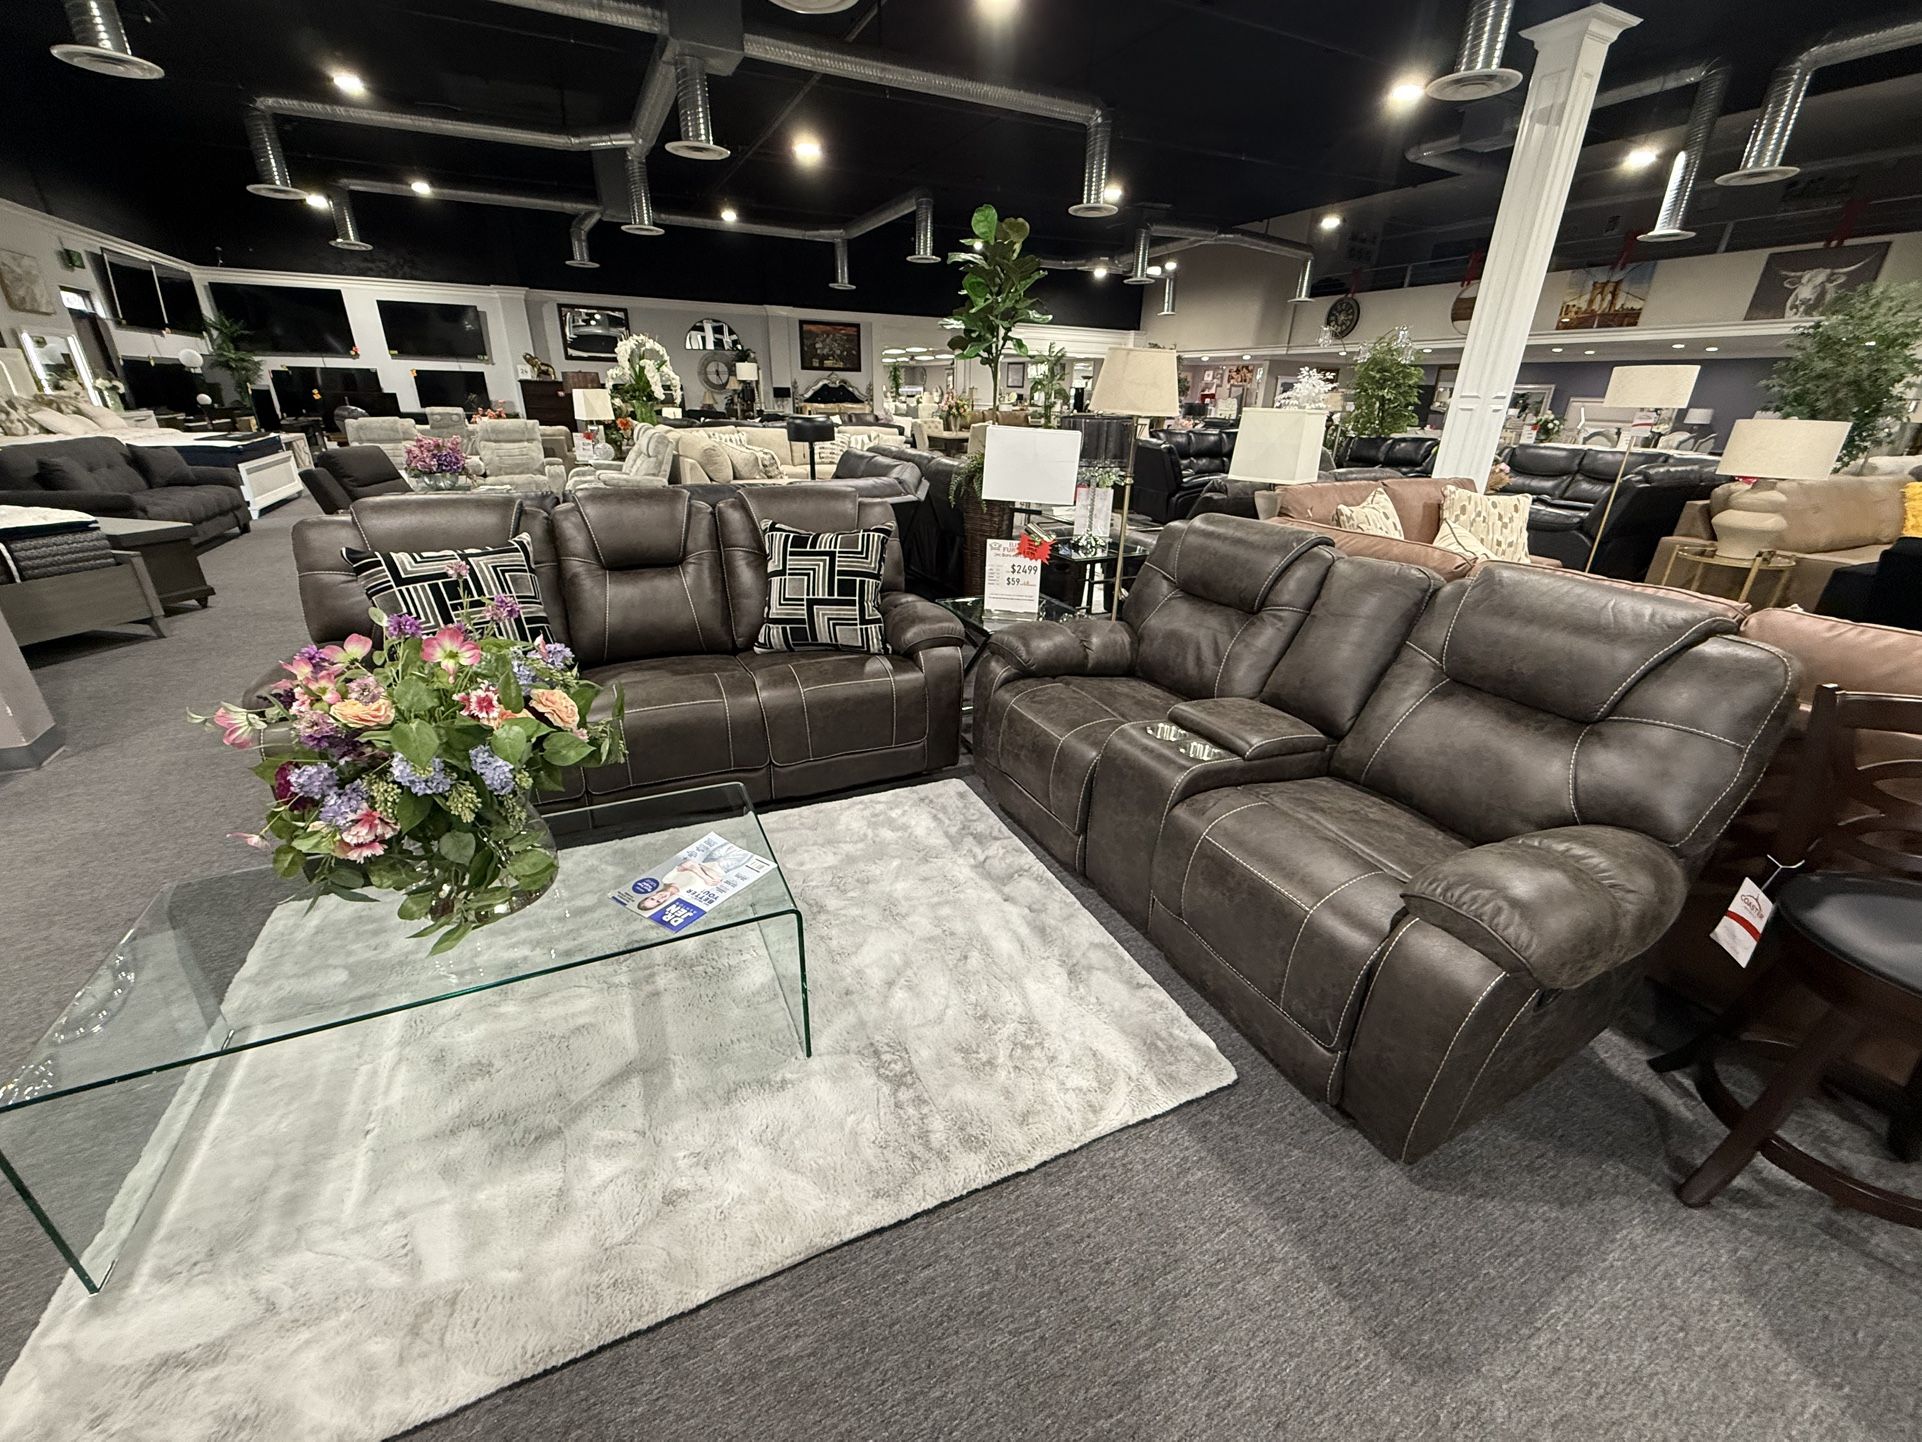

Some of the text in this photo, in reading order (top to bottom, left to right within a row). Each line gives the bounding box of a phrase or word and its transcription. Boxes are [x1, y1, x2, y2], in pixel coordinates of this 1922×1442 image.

[1010, 563, 1038, 575] $2499
[1006, 577, 1021, 586] $59
[686, 889, 715, 905] BETTER
[665, 904, 694, 919] JEN
[1741, 894, 1765, 919] COASTER
